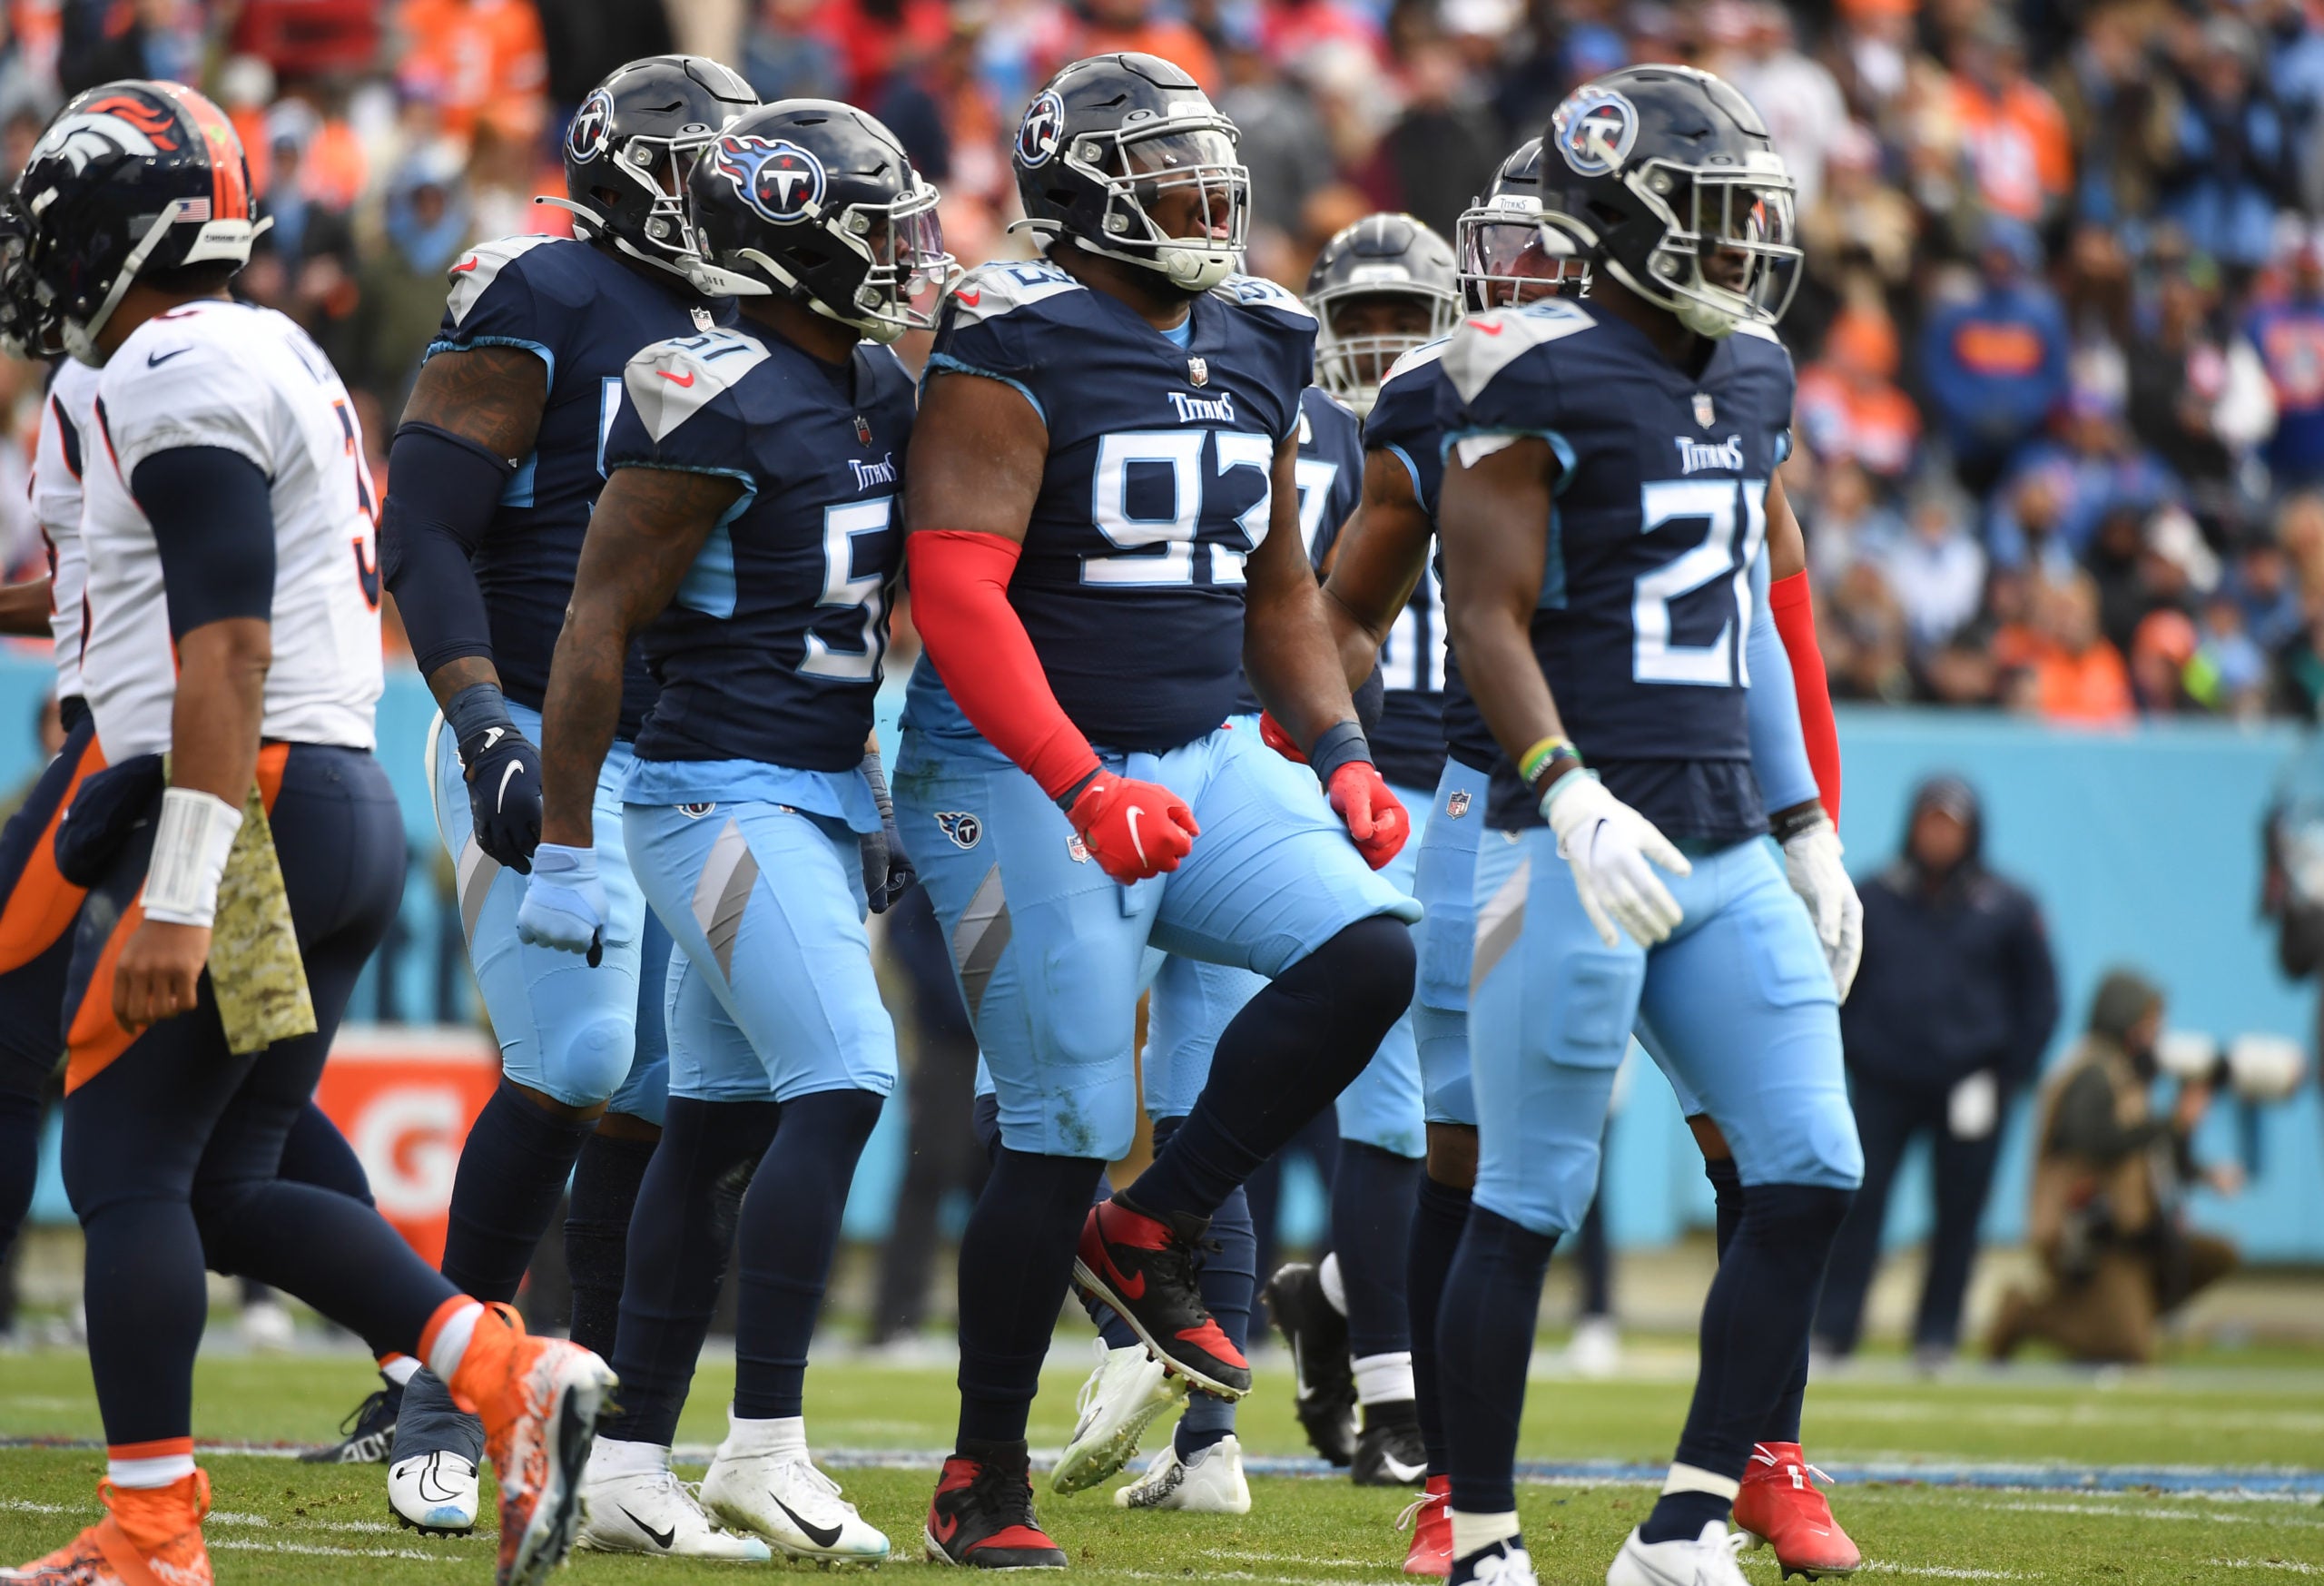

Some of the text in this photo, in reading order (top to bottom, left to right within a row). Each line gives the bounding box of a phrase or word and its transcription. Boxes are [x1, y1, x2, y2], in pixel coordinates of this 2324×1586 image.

[762, 170, 810, 211] T
[1167, 391, 1236, 424] TITANS
[848, 452, 897, 492] TITANS
[1078, 429, 1274, 586] 93
[794, 495, 897, 684] 5
[355, 1079, 466, 1220] G
